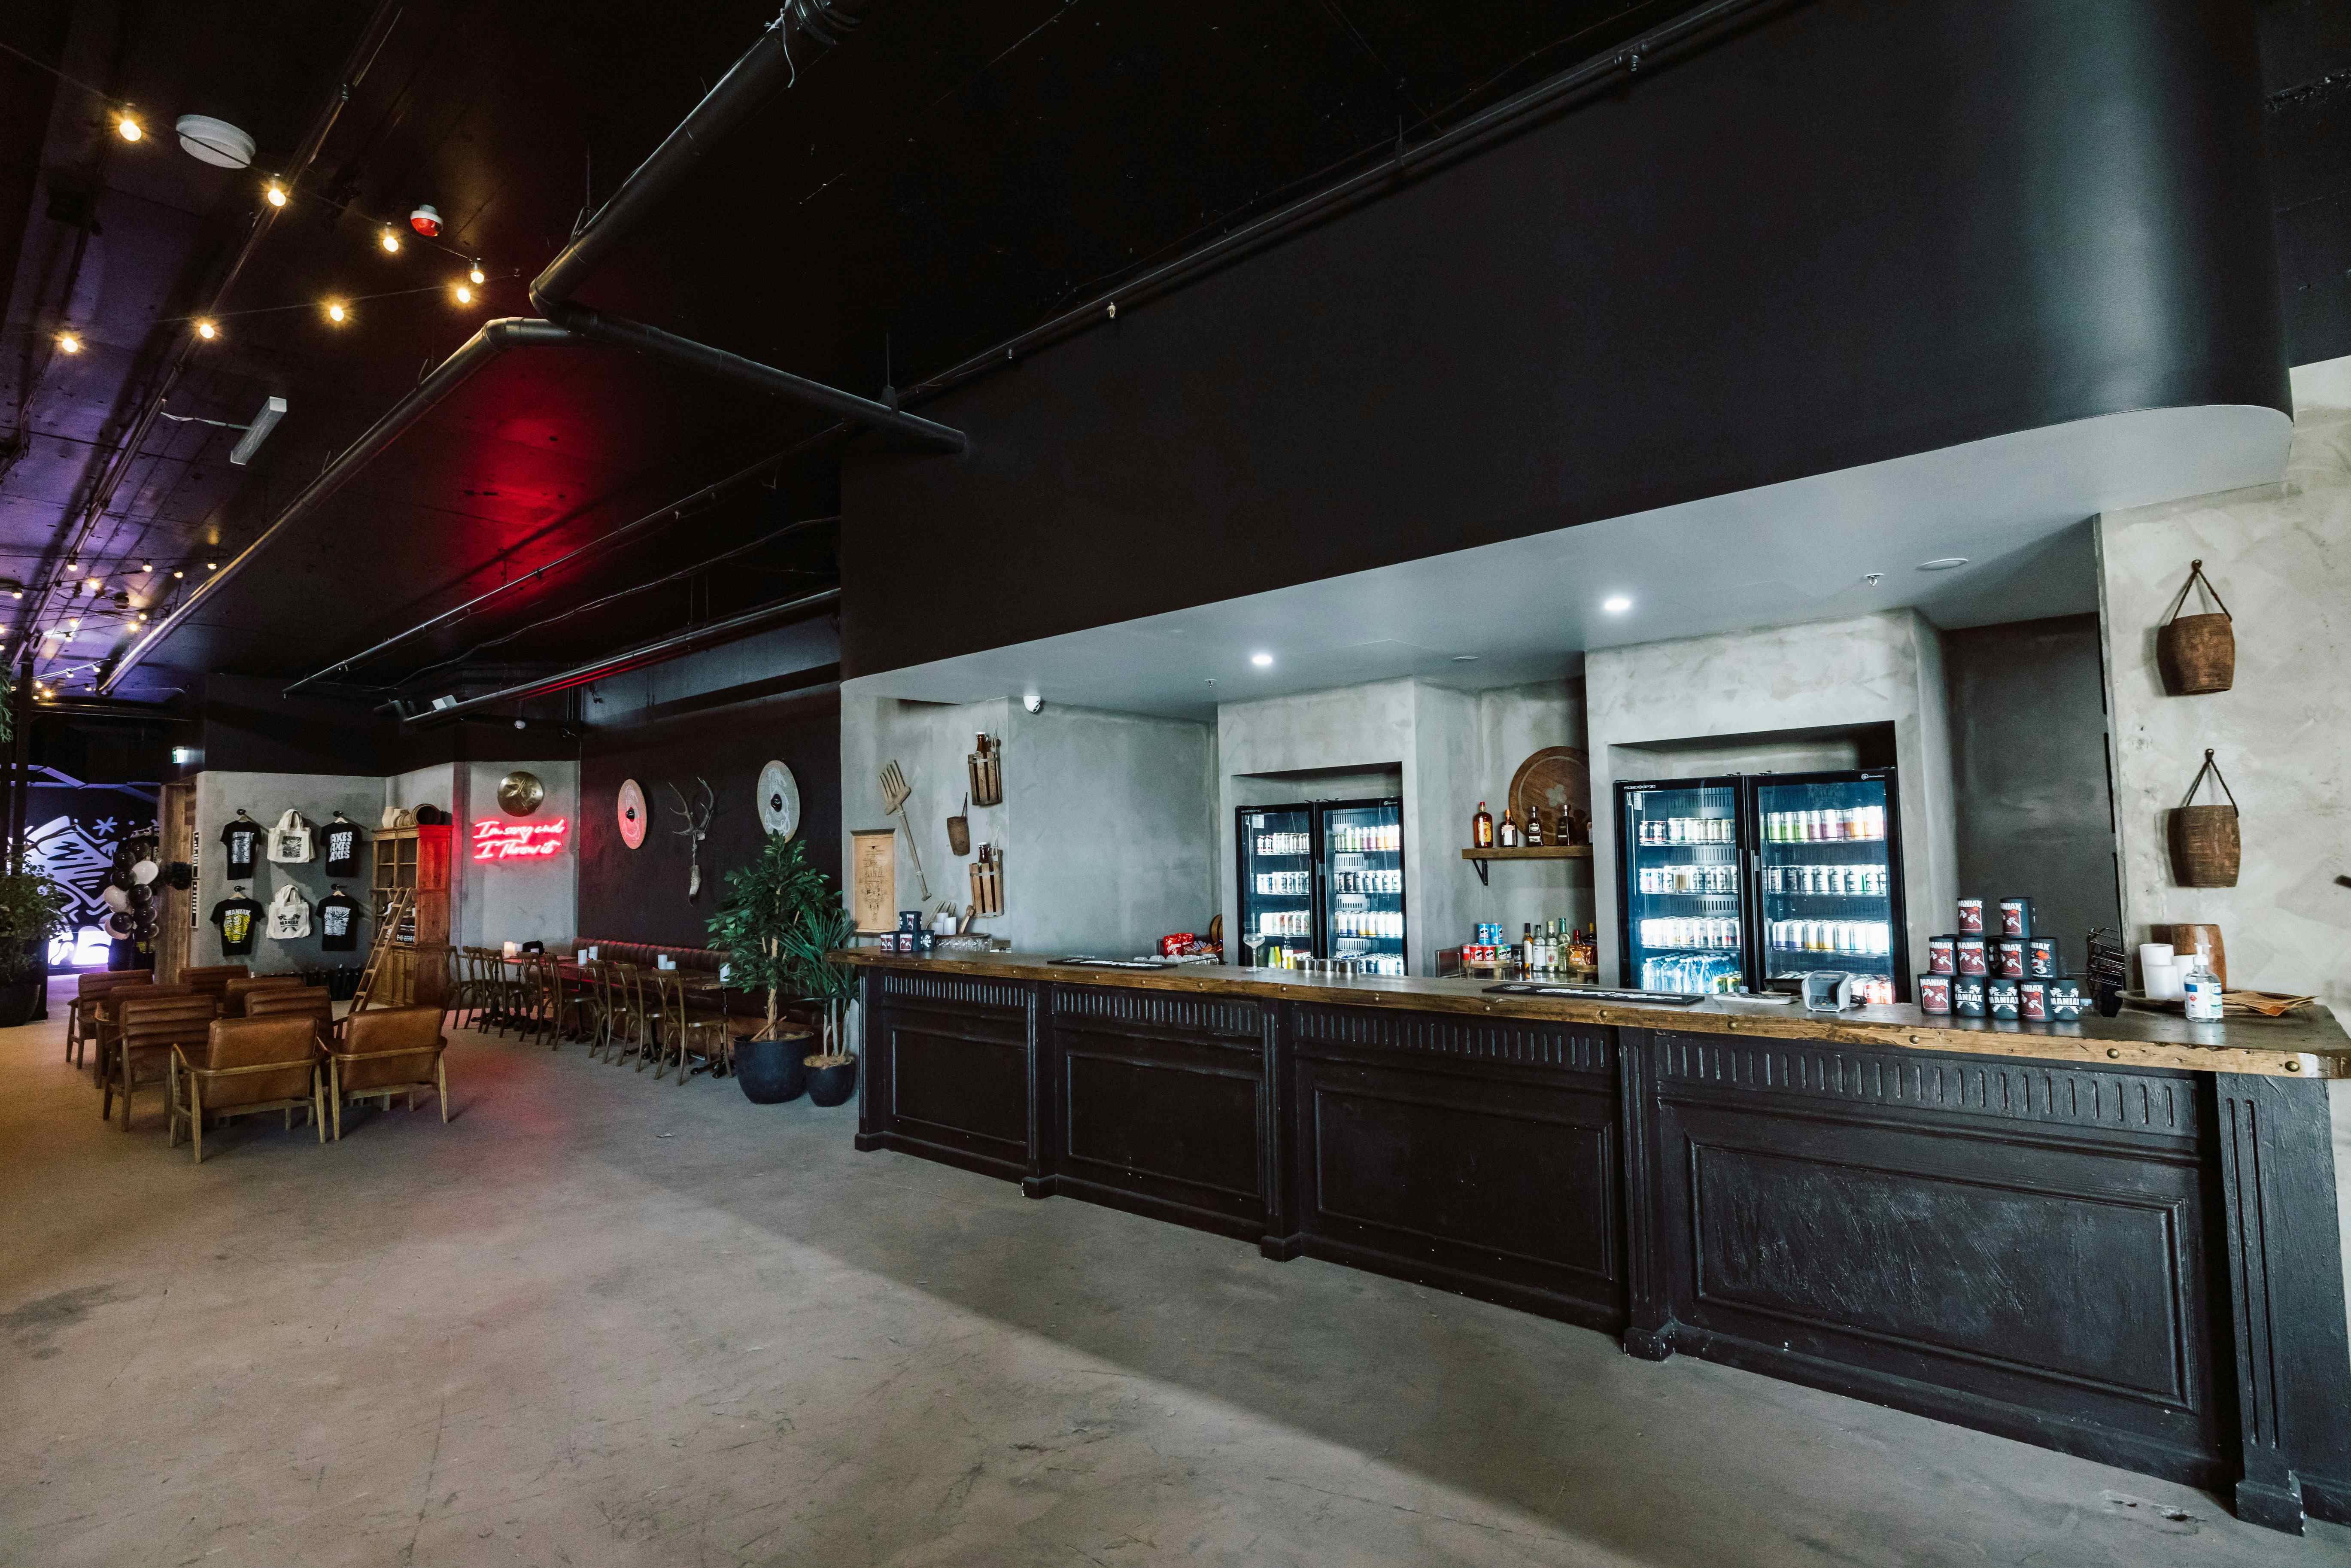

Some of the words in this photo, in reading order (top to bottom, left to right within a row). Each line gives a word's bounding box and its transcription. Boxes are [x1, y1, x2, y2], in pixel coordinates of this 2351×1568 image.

[535, 819, 565, 833] and
[330, 831, 352, 843] AXES
[330, 842, 351, 852] AXES
[540, 840, 561, 854] it
[328, 850, 350, 862] AXES
[1957, 900, 1982, 909] ANIAX
[1930, 942, 1953, 951] ANIAX
[1920, 978, 1949, 988] MANIAX
